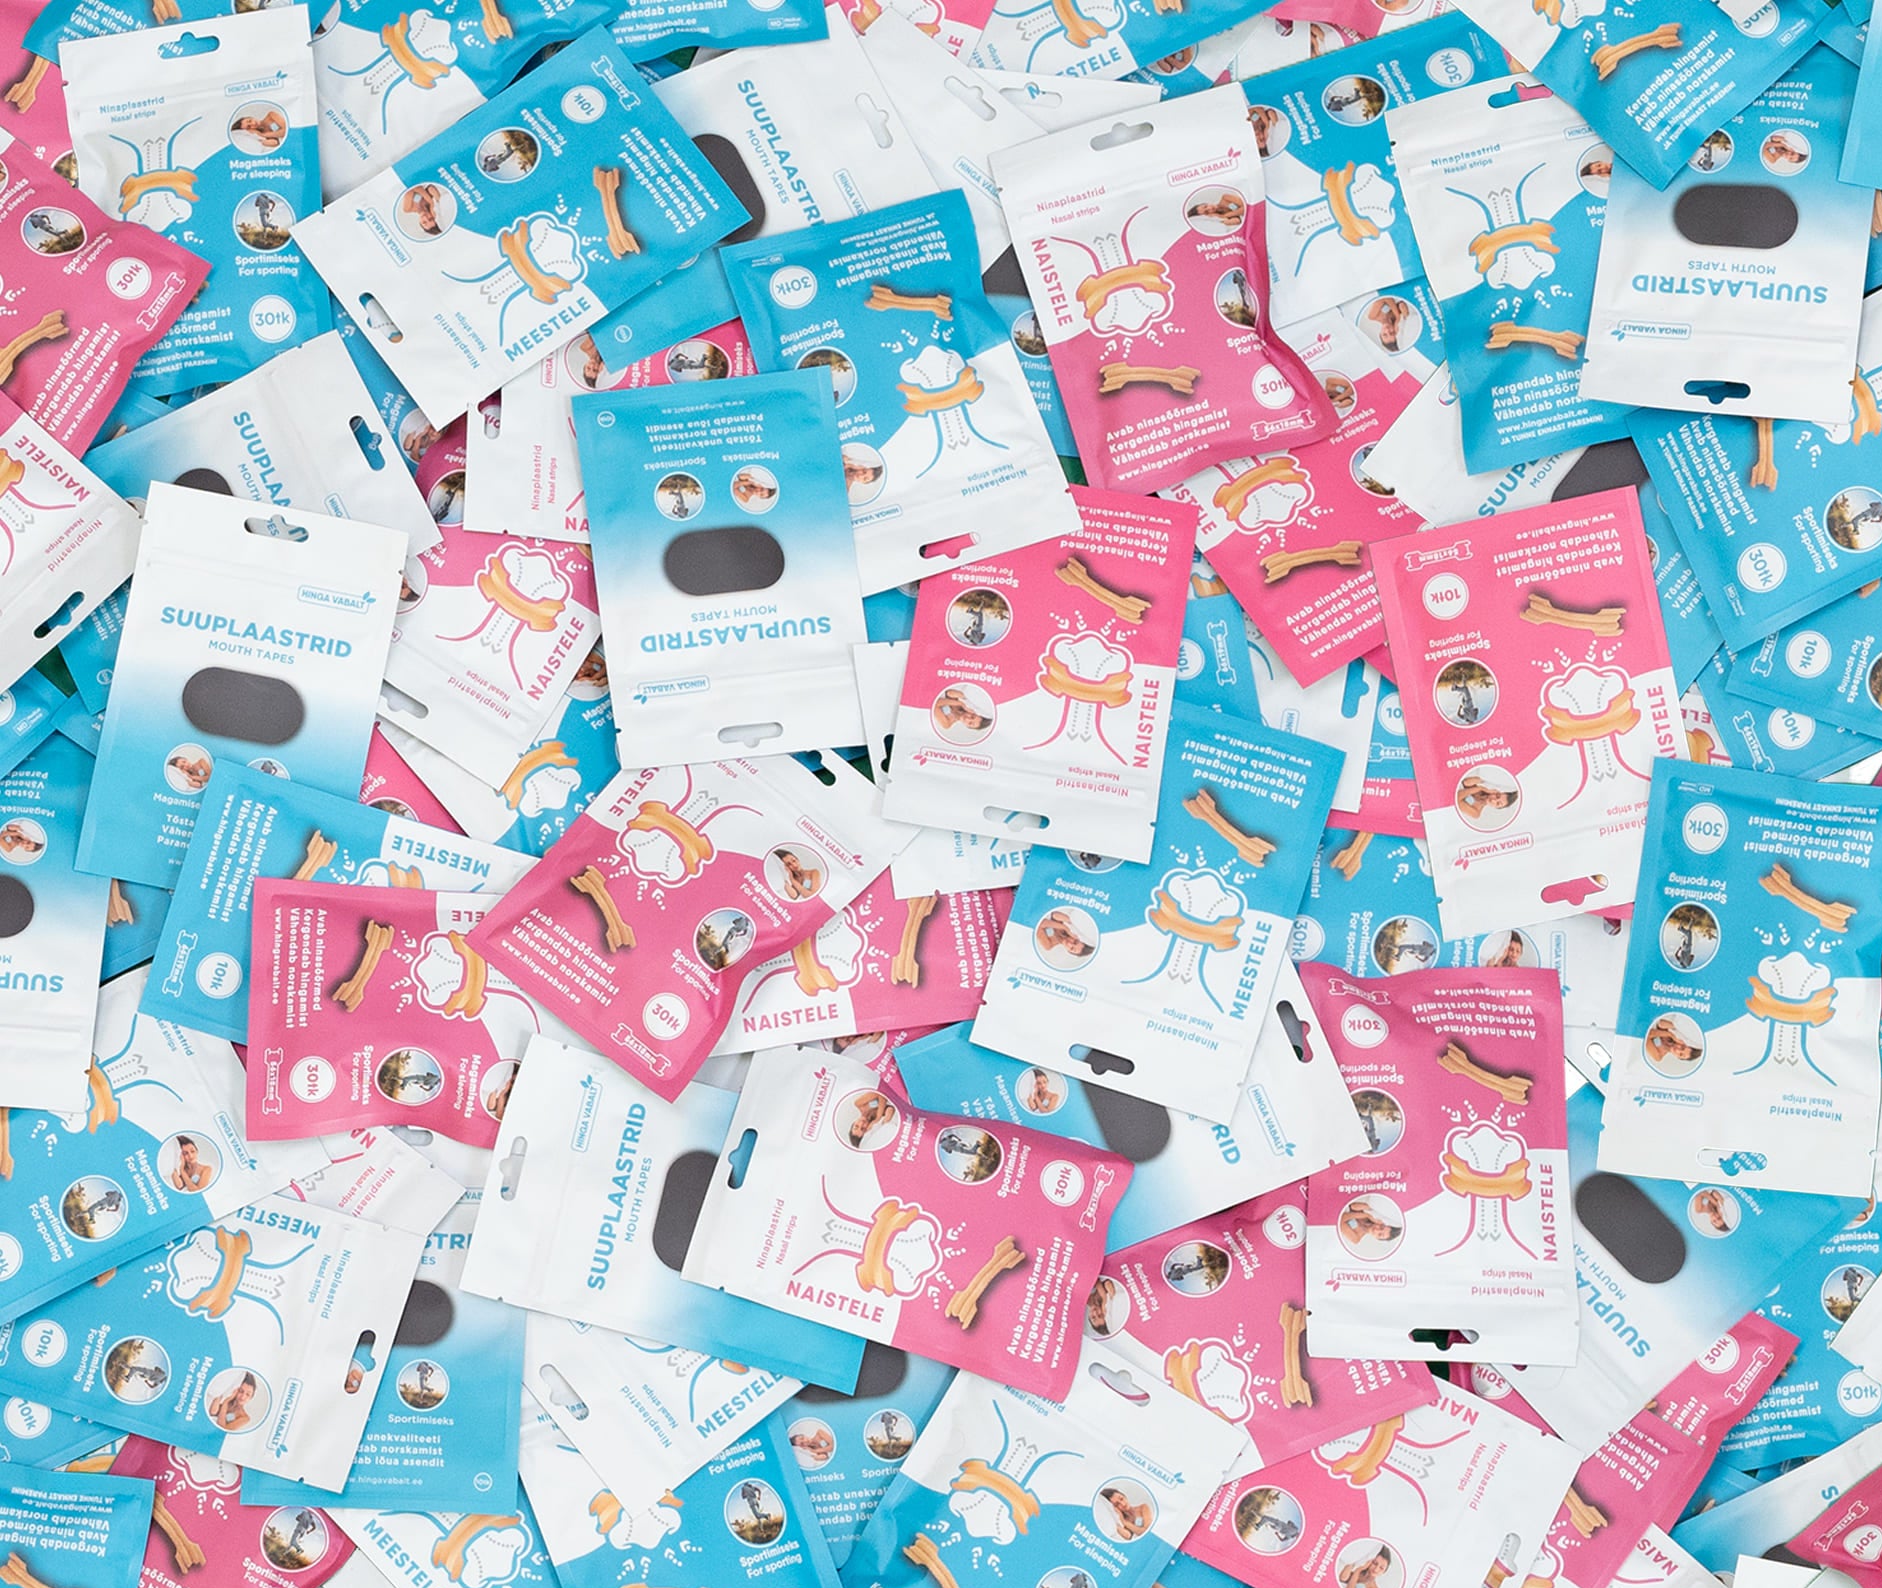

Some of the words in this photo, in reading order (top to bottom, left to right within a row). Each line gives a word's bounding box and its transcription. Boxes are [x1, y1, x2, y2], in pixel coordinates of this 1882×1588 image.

[99, 95, 165, 114] Ninaplaastrid
[229, 156, 292, 170] Magamiseks
[231, 171, 248, 180] For
[249, 168, 292, 180] sleeping
[1036, 185, 1106, 213] Ninaplaastrid
[234, 253, 300, 267] Sportimiseks
[238, 265, 255, 277] For
[256, 265, 299, 277] sporting
[1031, 237, 1073, 327] NAISTELE
[255, 311, 291, 327] 30tk
[504, 296, 592, 363] MEESTELE
[1106, 424, 1135, 442] Avab
[1136, 398, 1210, 431] ninasõõrmed
[1109, 425, 1172, 454] Kergendab
[1172, 407, 1228, 432] hingamist
[1112, 440, 1169, 466] Vähendab
[1171, 420, 1231, 447] norskamist
[1117, 443, 1209, 481] www.hingavabalt.ee
[297, 588, 331, 603] HINGA
[332, 595, 366, 609] VABALT
[733, 604, 778, 618] MOUTH
[690, 609, 730, 623] TAPES
[160, 606, 352, 658] SUUPLAASTRID
[640, 616, 832, 653] SUUPLAASTRID
[208, 639, 253, 657] MOUTH
[256, 648, 295, 665] TAPES
[1229, 920, 1273, 1021] MEESTELE
[1539, 1163, 1558, 1262] NAISTELE
